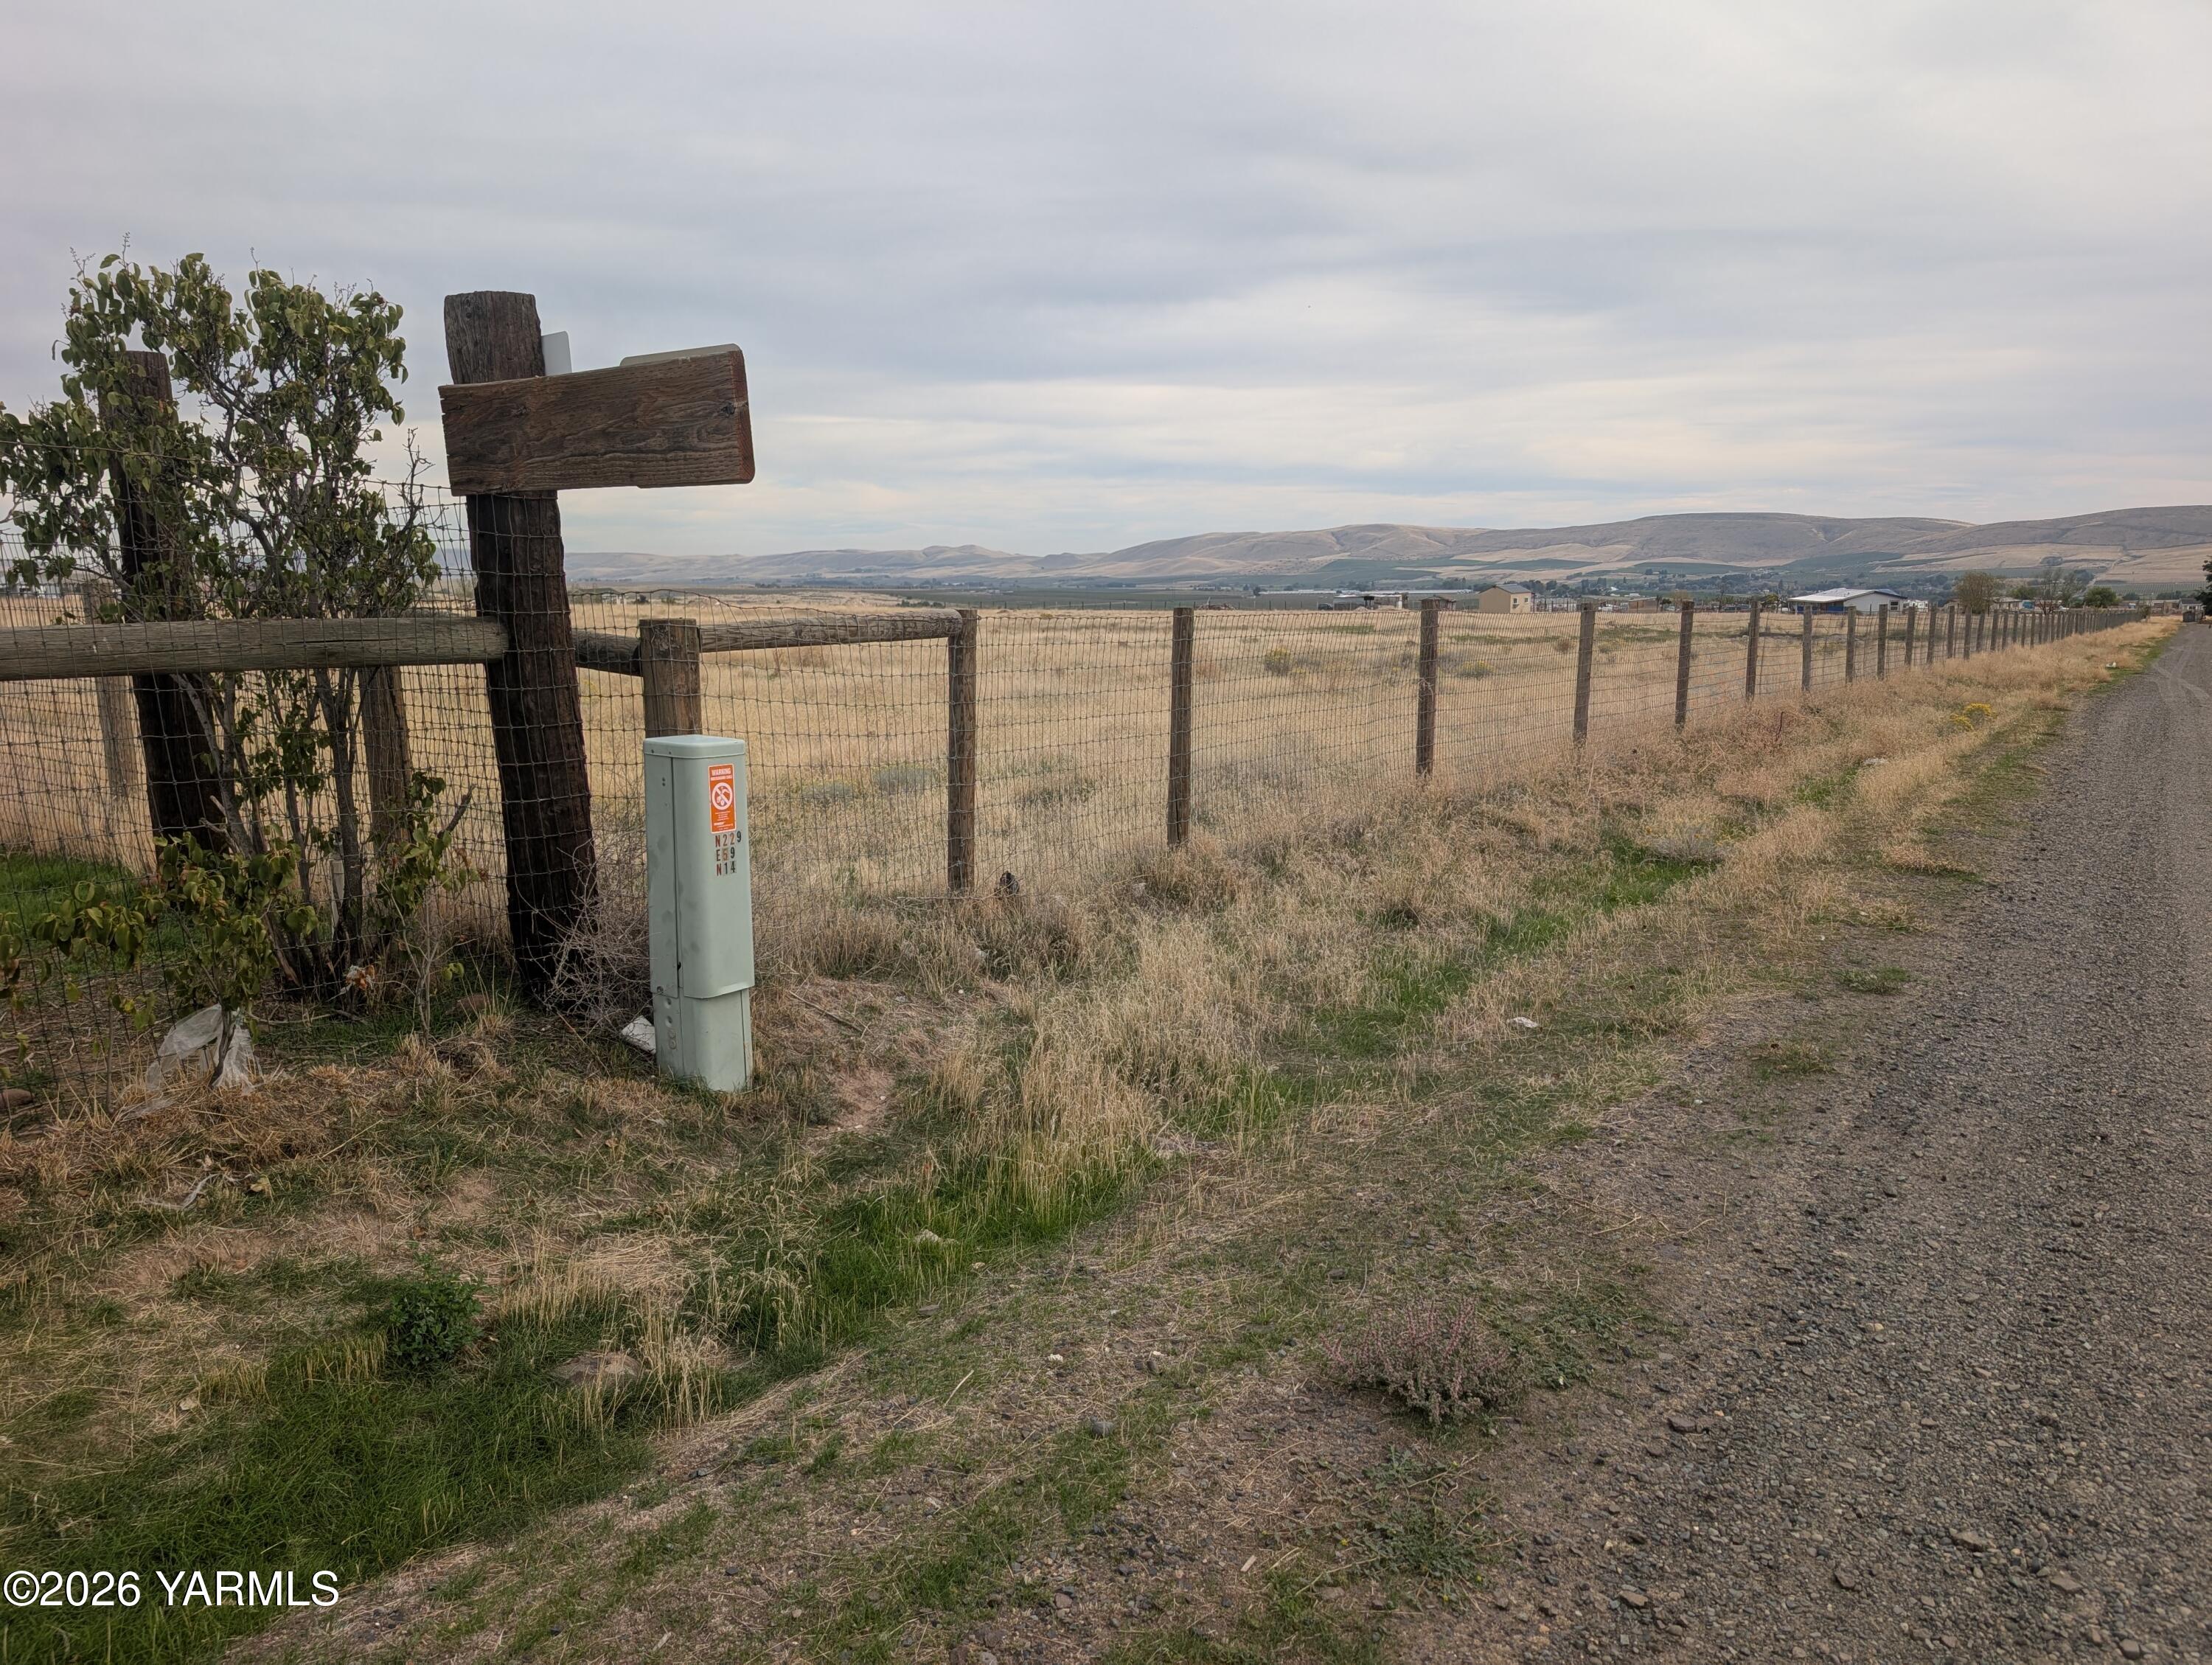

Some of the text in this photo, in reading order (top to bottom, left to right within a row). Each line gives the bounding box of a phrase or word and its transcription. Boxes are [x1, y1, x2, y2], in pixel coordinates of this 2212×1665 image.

[715, 830, 742, 847] N229
[716, 847, 735, 862] E59
[716, 861, 736, 876] N14
